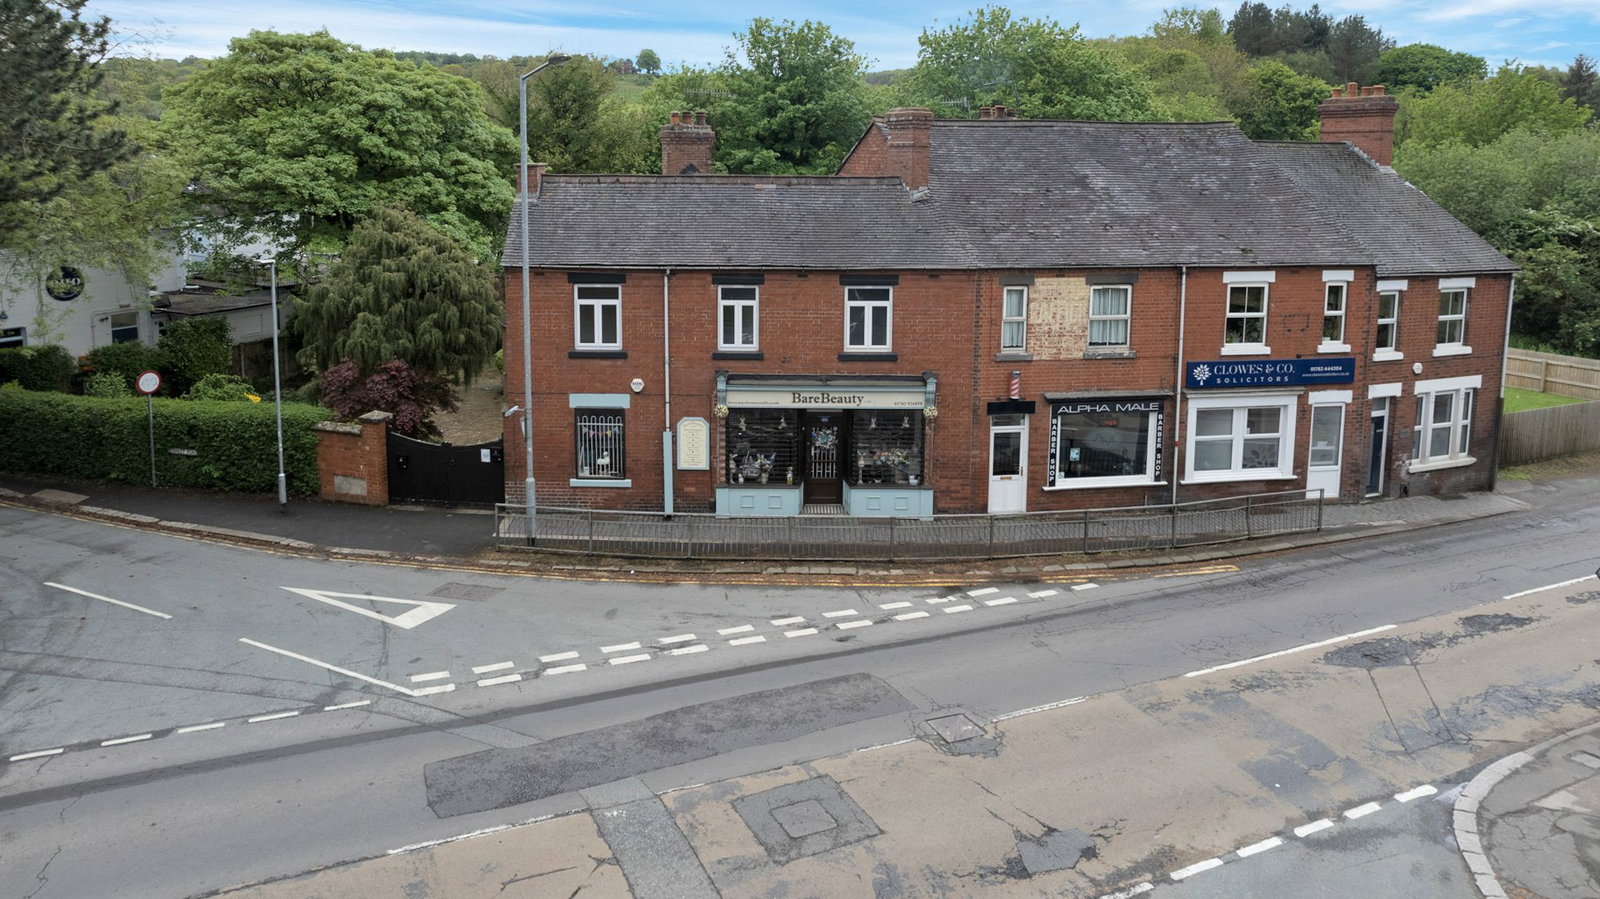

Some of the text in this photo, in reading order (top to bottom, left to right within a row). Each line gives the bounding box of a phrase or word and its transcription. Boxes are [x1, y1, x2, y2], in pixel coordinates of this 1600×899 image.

[1214, 363, 1295, 375] CLOWES & CO.
[1216, 376, 1289, 384] SOLICITORS
[792, 392, 864, 406] BareBeauty
[1057, 402, 1159, 414] ALPHA MALE
